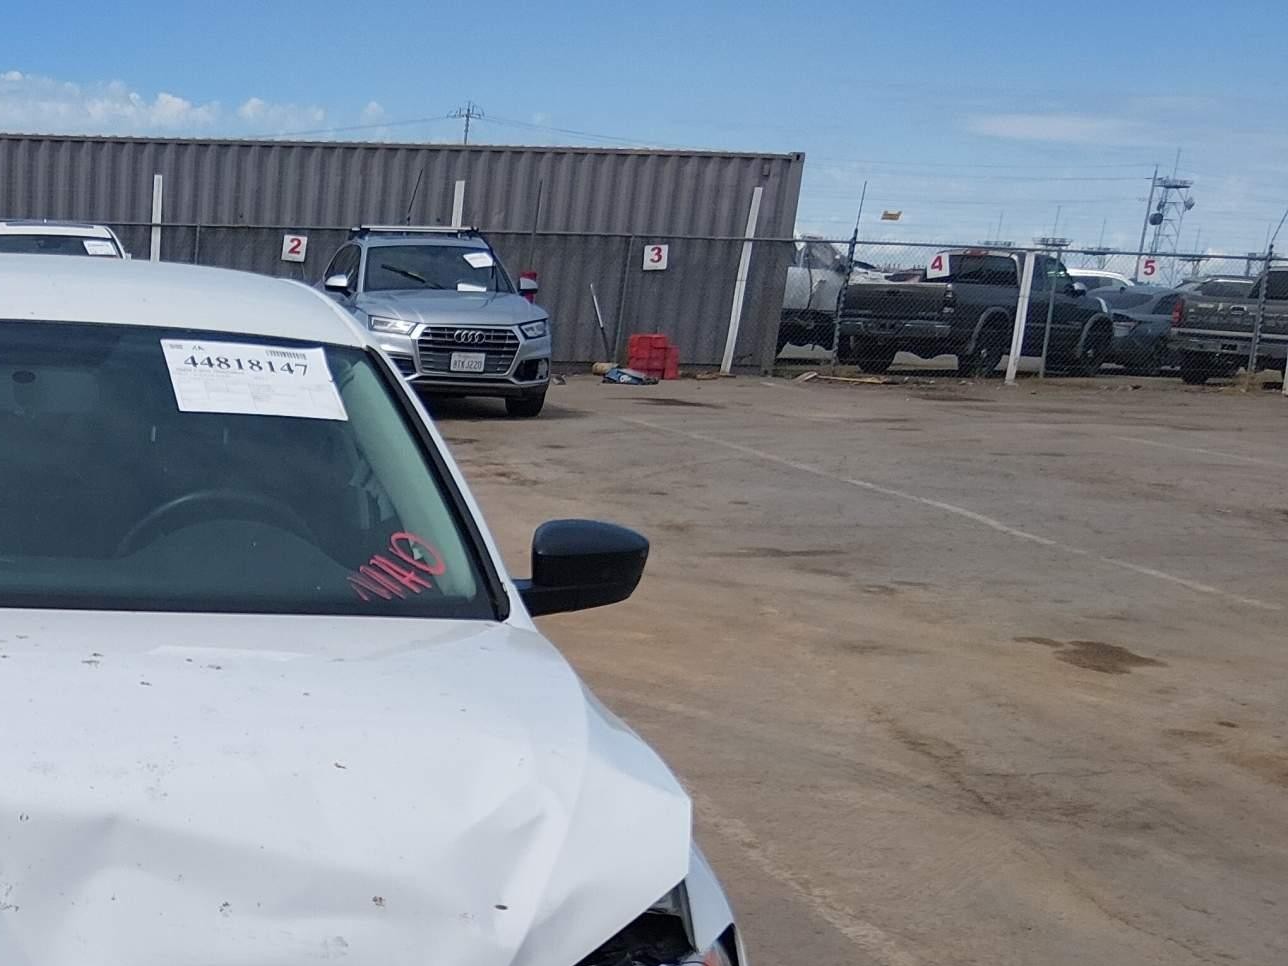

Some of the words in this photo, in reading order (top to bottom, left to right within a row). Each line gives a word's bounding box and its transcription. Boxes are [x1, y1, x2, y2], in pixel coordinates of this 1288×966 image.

[288, 238, 302, 255] 2
[650, 247, 662, 263] 3
[931, 255, 943, 271] 4
[1143, 260, 1155, 276] 5
[183, 355, 308, 376] 44818147
